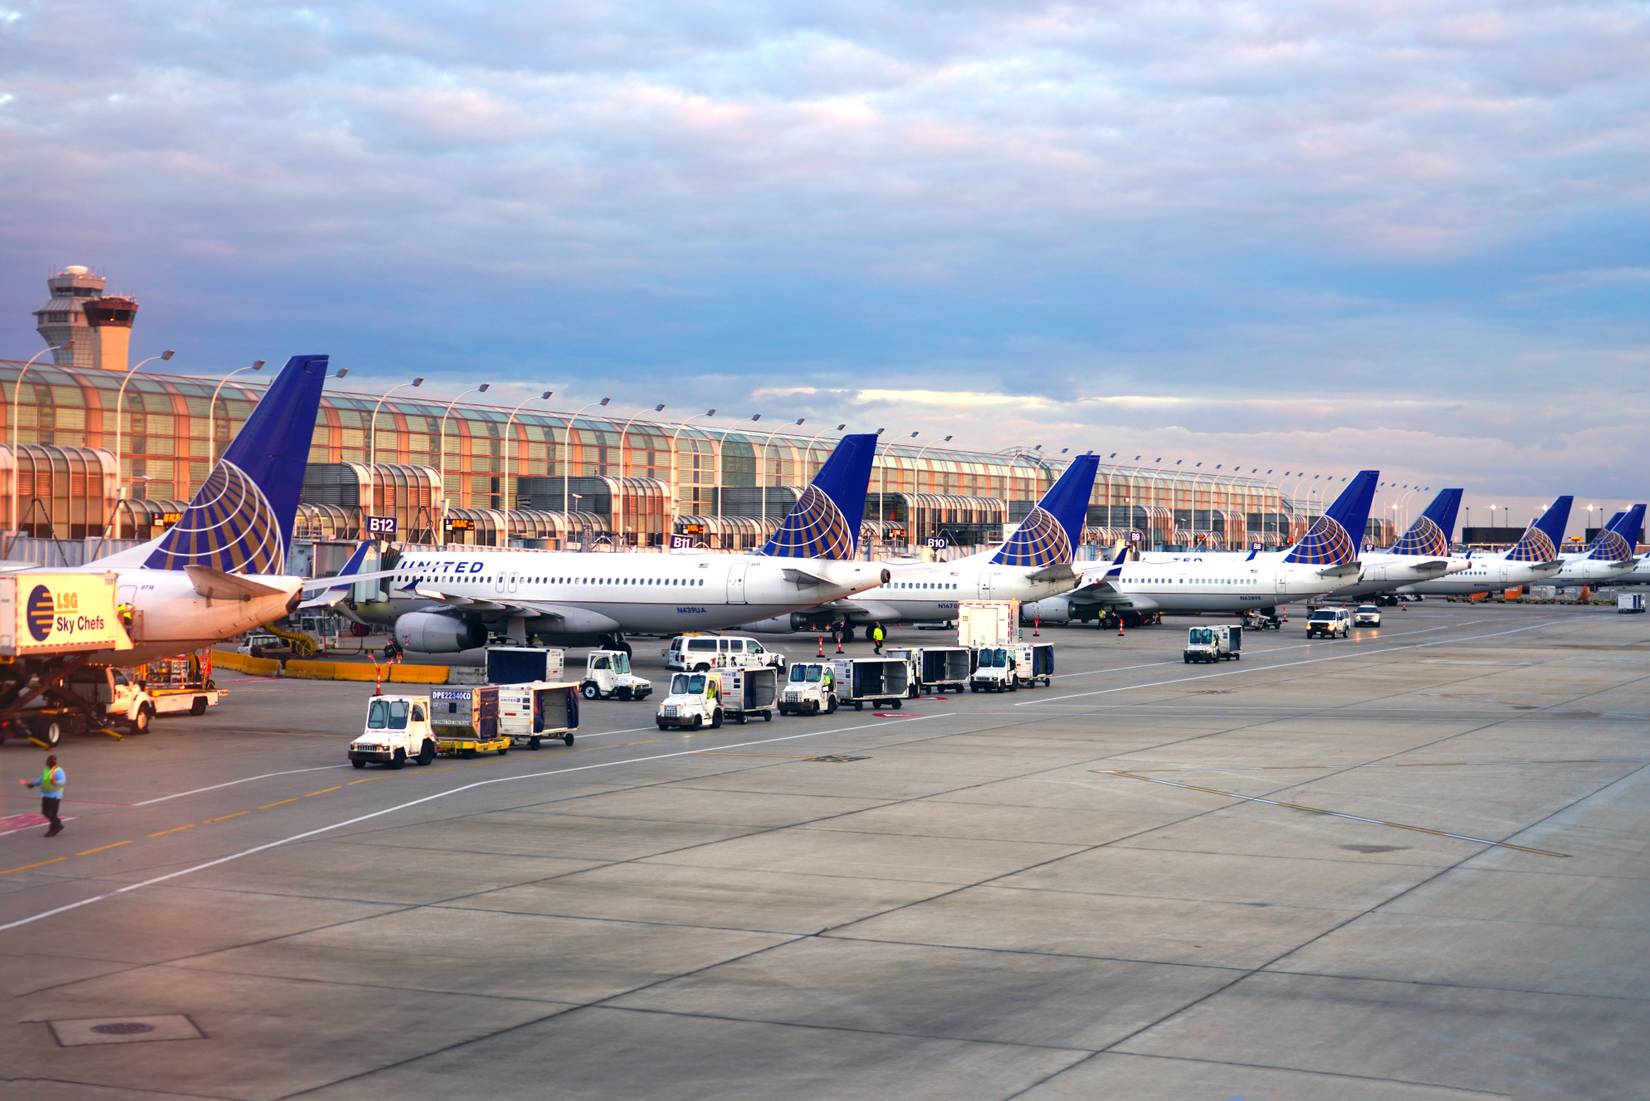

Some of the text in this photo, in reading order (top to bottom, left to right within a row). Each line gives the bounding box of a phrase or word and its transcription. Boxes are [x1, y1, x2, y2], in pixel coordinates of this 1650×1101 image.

[370, 518, 394, 532] B12
[673, 537, 691, 548] B11
[927, 538, 945, 548] B10
[400, 560, 484, 573] UNITED
[57, 592, 78, 609] LSG
[56, 615, 105, 634] Sky Chefs
